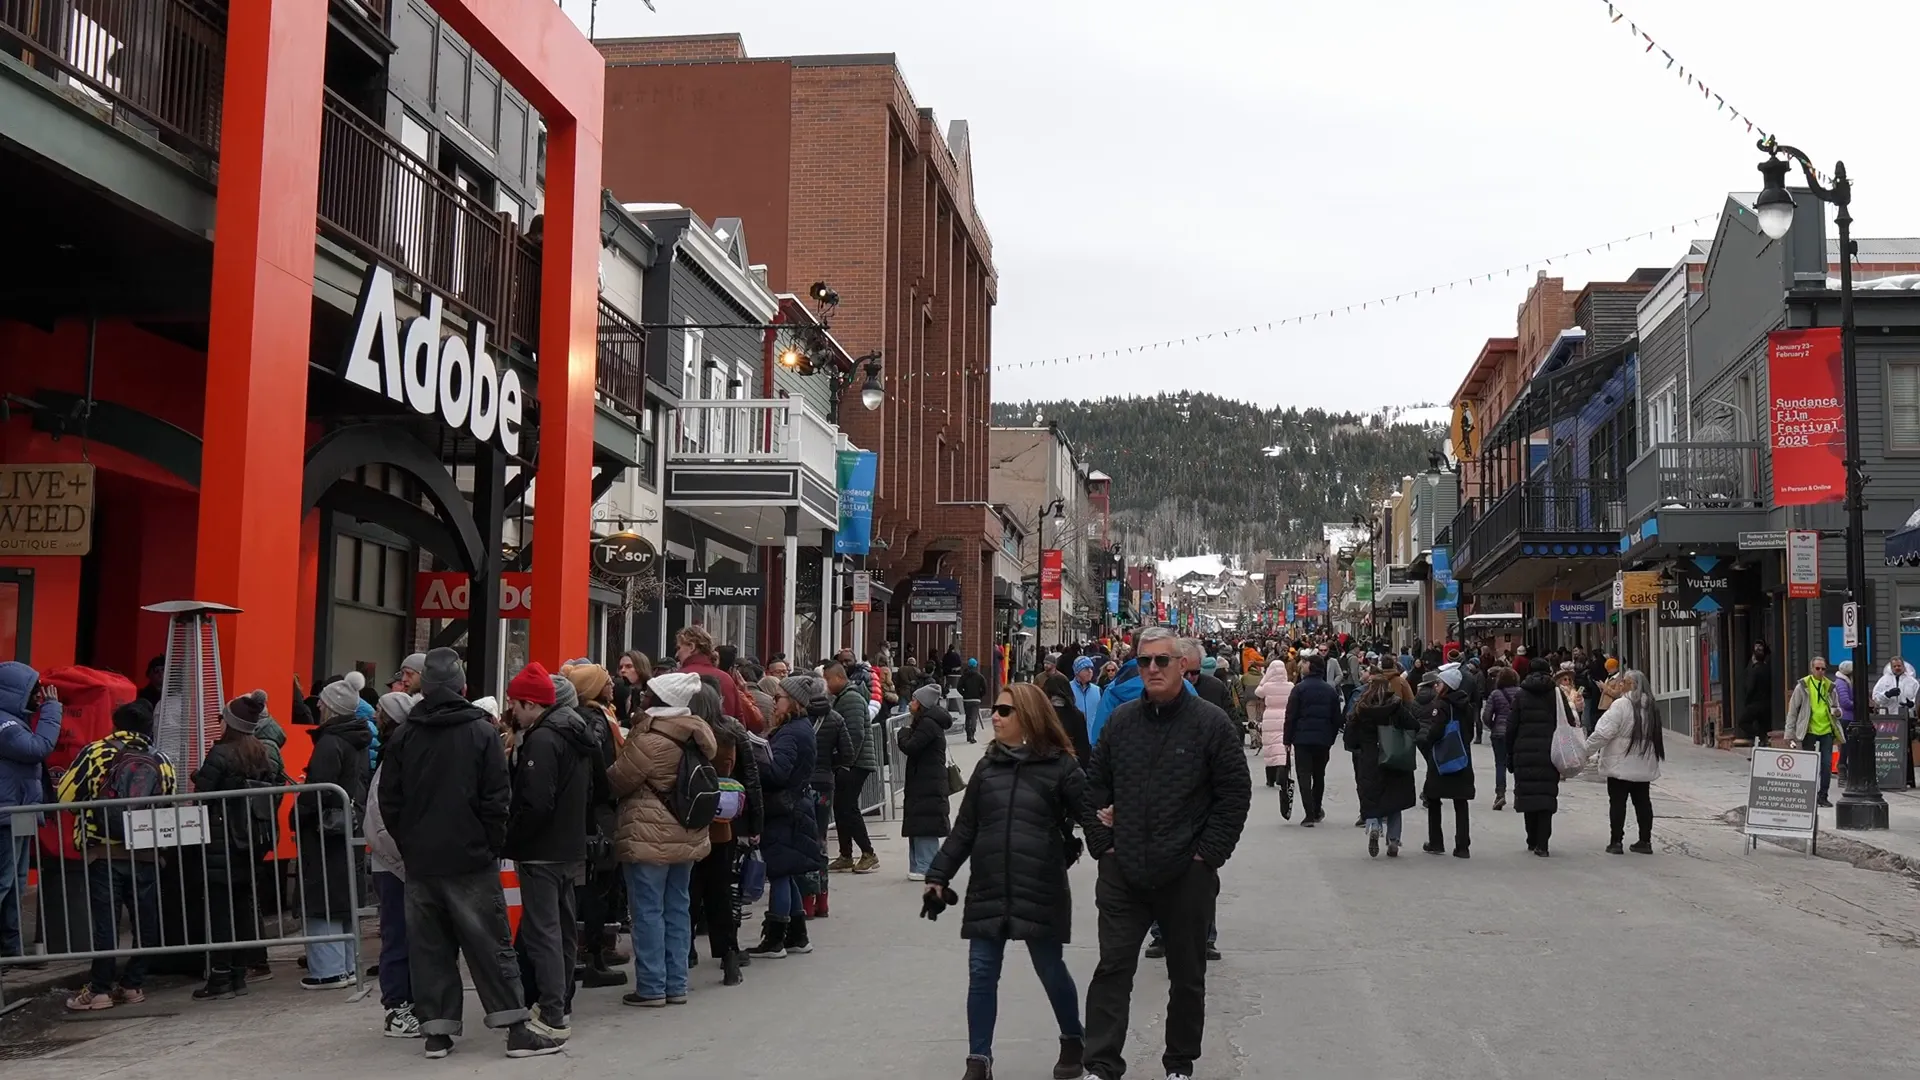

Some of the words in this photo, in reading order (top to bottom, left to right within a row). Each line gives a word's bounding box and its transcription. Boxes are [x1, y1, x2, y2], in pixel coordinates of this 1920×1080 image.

[345, 265, 522, 456] Adobe
[1776, 397, 1838, 408] Sundance
[1777, 410, 1808, 421] Film
[1777, 421, 1838, 433] Festival
[1778, 435, 1808, 446] 2025
[1686, 577, 1728, 588] VULTURE
[708, 587, 733, 596] FINE
[734, 587, 760, 596] ART
[1559, 604, 1596, 612] SUNRISE
[1767, 780, 1800, 788] PERMITTED
